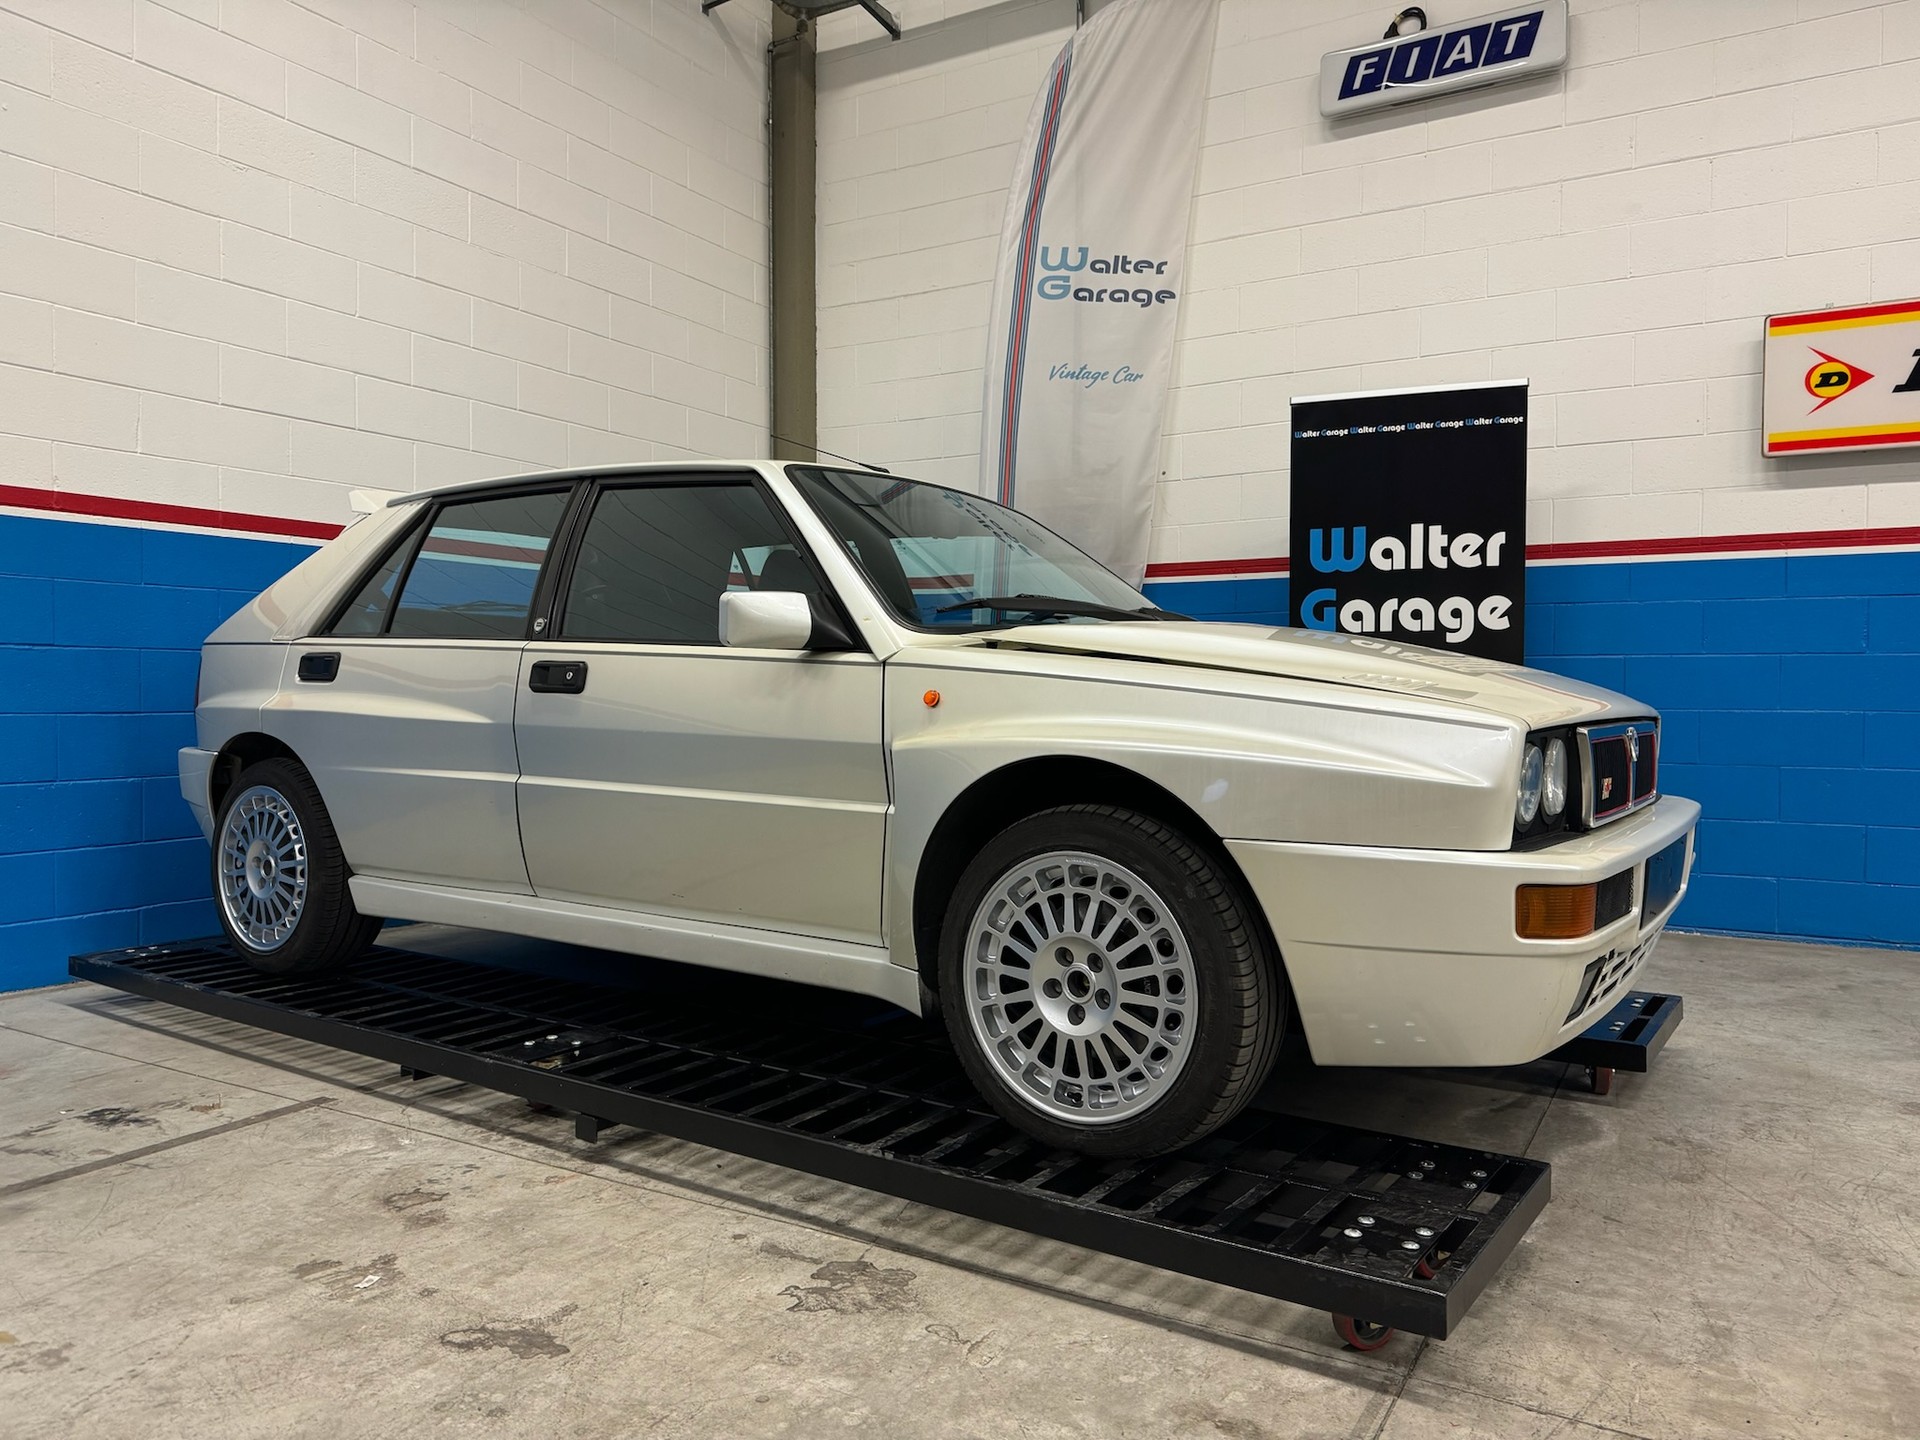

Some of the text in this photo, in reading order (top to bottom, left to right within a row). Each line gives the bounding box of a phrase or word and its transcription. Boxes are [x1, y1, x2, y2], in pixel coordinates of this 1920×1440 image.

[1352, 20, 1531, 90] FIAT
[1040, 246, 1168, 275] Walter
[1037, 275, 1176, 308] Garage
[1049, 362, 1144, 389] Vintage Car
[1813, 371, 1849, 389] D
[1294, 416, 1524, 438] Walter Garage Walter Garage Walter Garage Walter Garage
[1309, 523, 1506, 573] Walter
[1300, 588, 1513, 643] Garage
